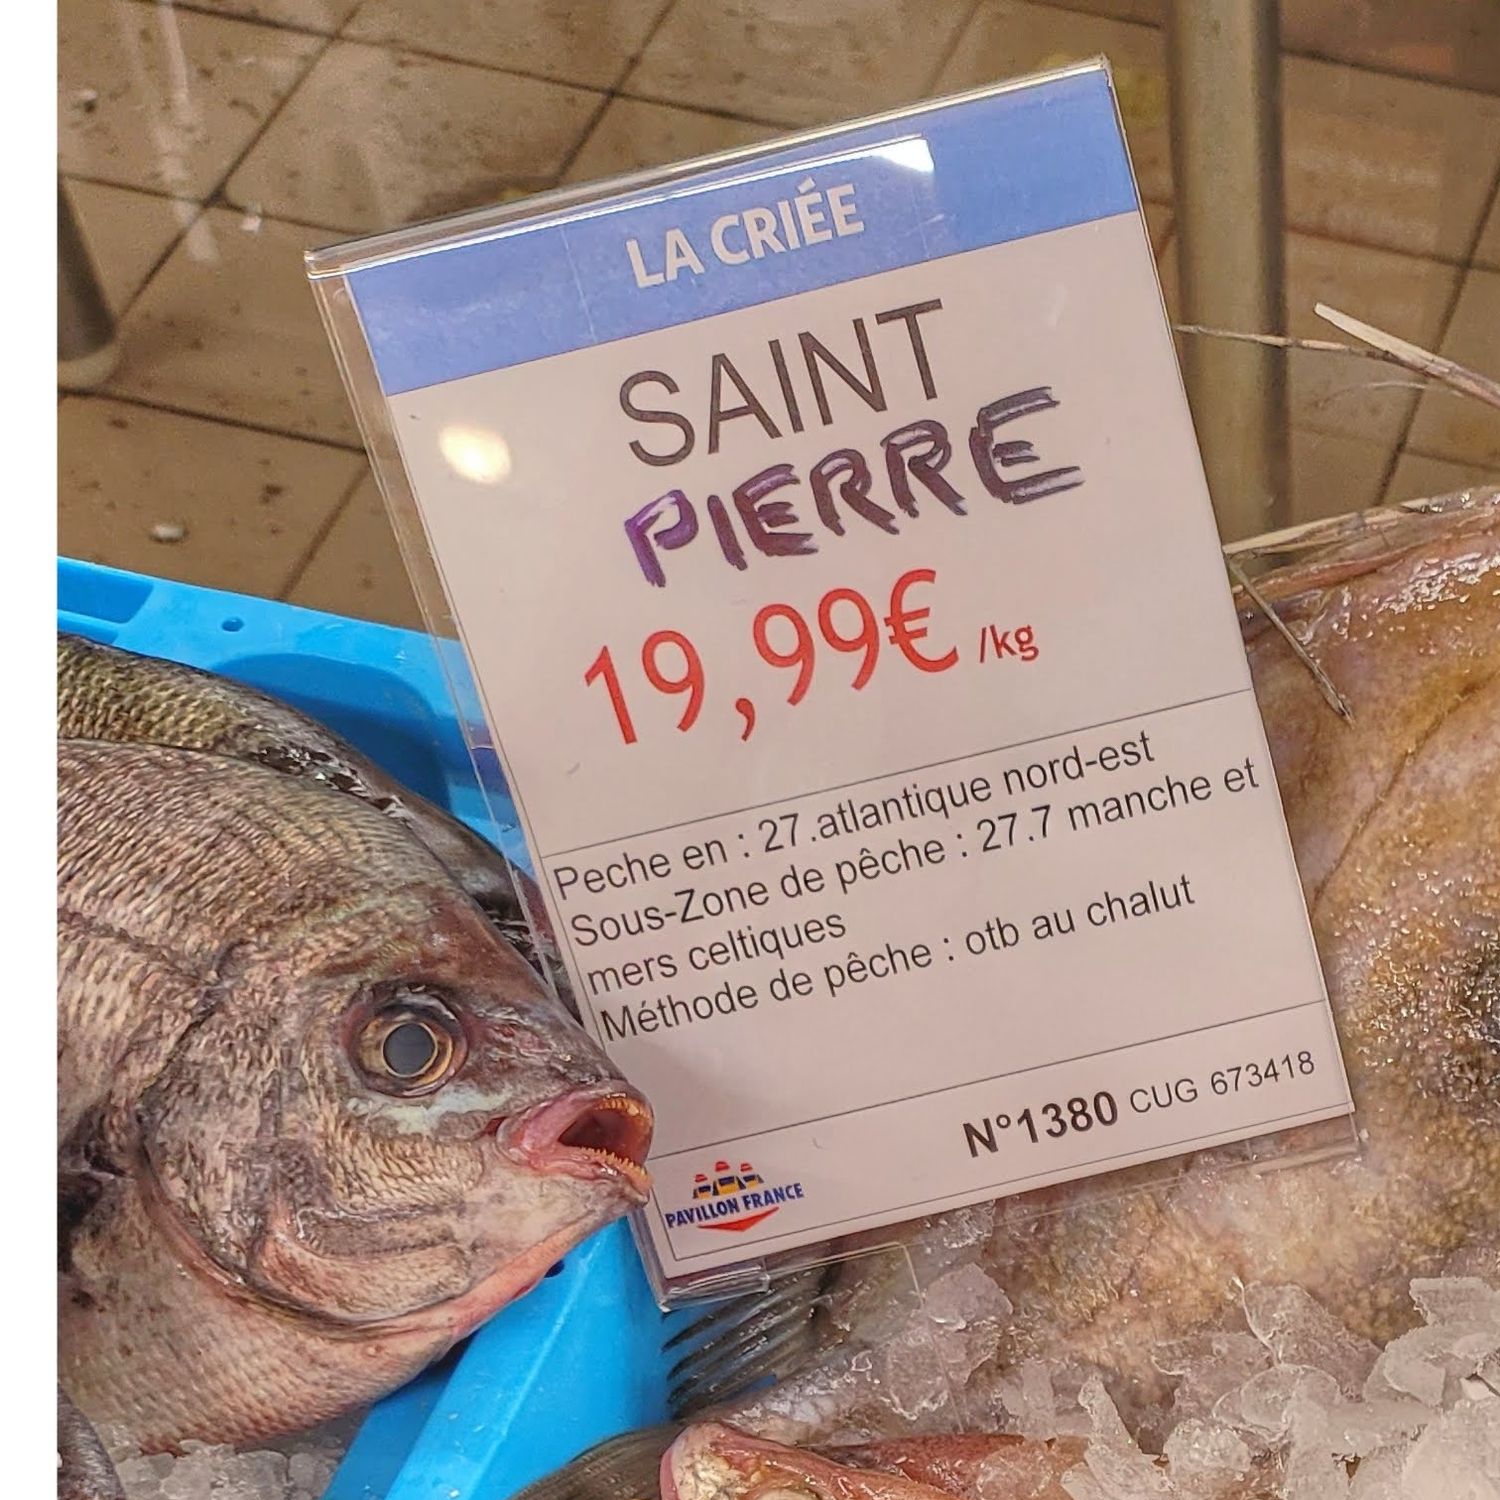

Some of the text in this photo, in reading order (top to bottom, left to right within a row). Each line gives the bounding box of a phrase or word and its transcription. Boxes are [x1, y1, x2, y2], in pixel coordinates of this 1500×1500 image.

[625, 178, 866, 289] LA CRIÉE
[618, 298, 945, 467] SAINT
[624, 385, 1086, 588] PIERRE
[584, 567, 1040, 745] 19,99€ /kg
[553, 852, 671, 900] Peche
[683, 840, 727, 870] en
[1003, 730, 1155, 796] nord-est
[571, 881, 769, 946] Sous-Zone
[780, 864, 825, 898] de
[835, 839, 945, 895] pêche
[977, 804, 1050, 852] 27.7
[1068, 775, 1212, 831] manche
[1224, 757, 1259, 792] et
[587, 914, 847, 996] mers celtiques
[600, 981, 759, 1041] Méthode
[770, 968, 813, 1001] de
[824, 943, 932, 997] pêche
[966, 917, 1019, 955] otb
[1032, 909, 1075, 939] au
[1087, 874, 1195, 926] chalut
[963, 1051, 1314, 1158] N°1380 CUG 673418
[665, 1183, 804, 1228] PAVILLON FRANCE
